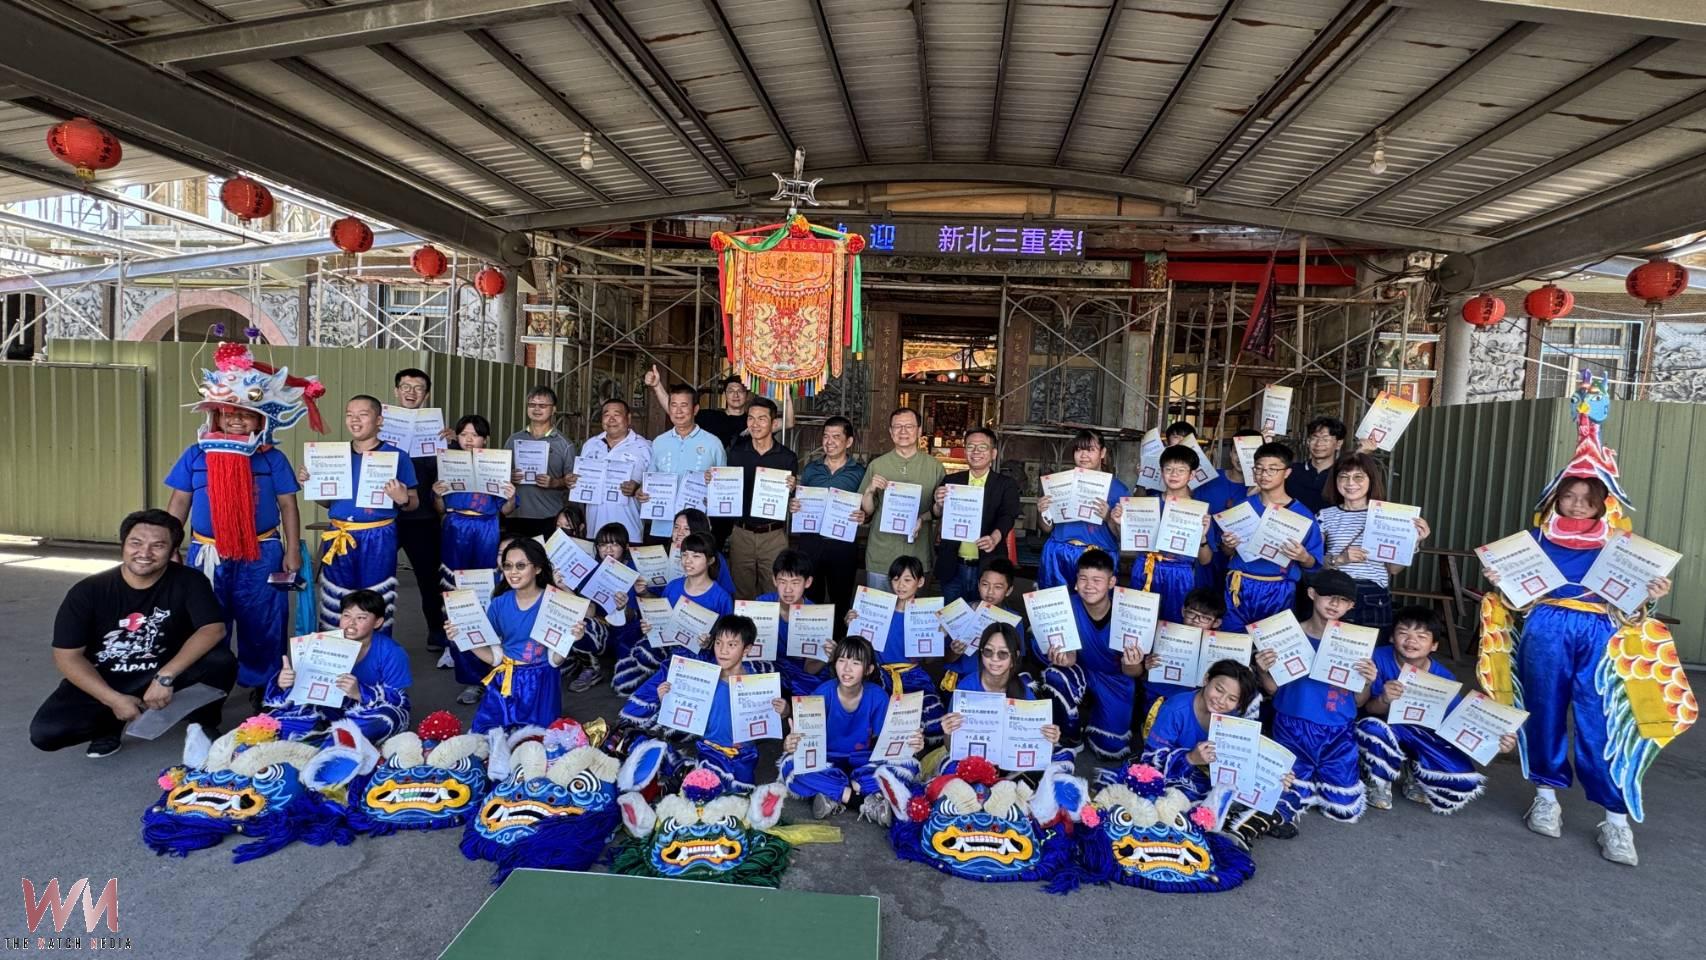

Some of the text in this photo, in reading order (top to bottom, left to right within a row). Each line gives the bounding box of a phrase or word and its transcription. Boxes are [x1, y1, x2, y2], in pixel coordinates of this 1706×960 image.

[938, 225, 1083, 256] 新北三重奉
[110, 662, 158, 673] JAPAN
